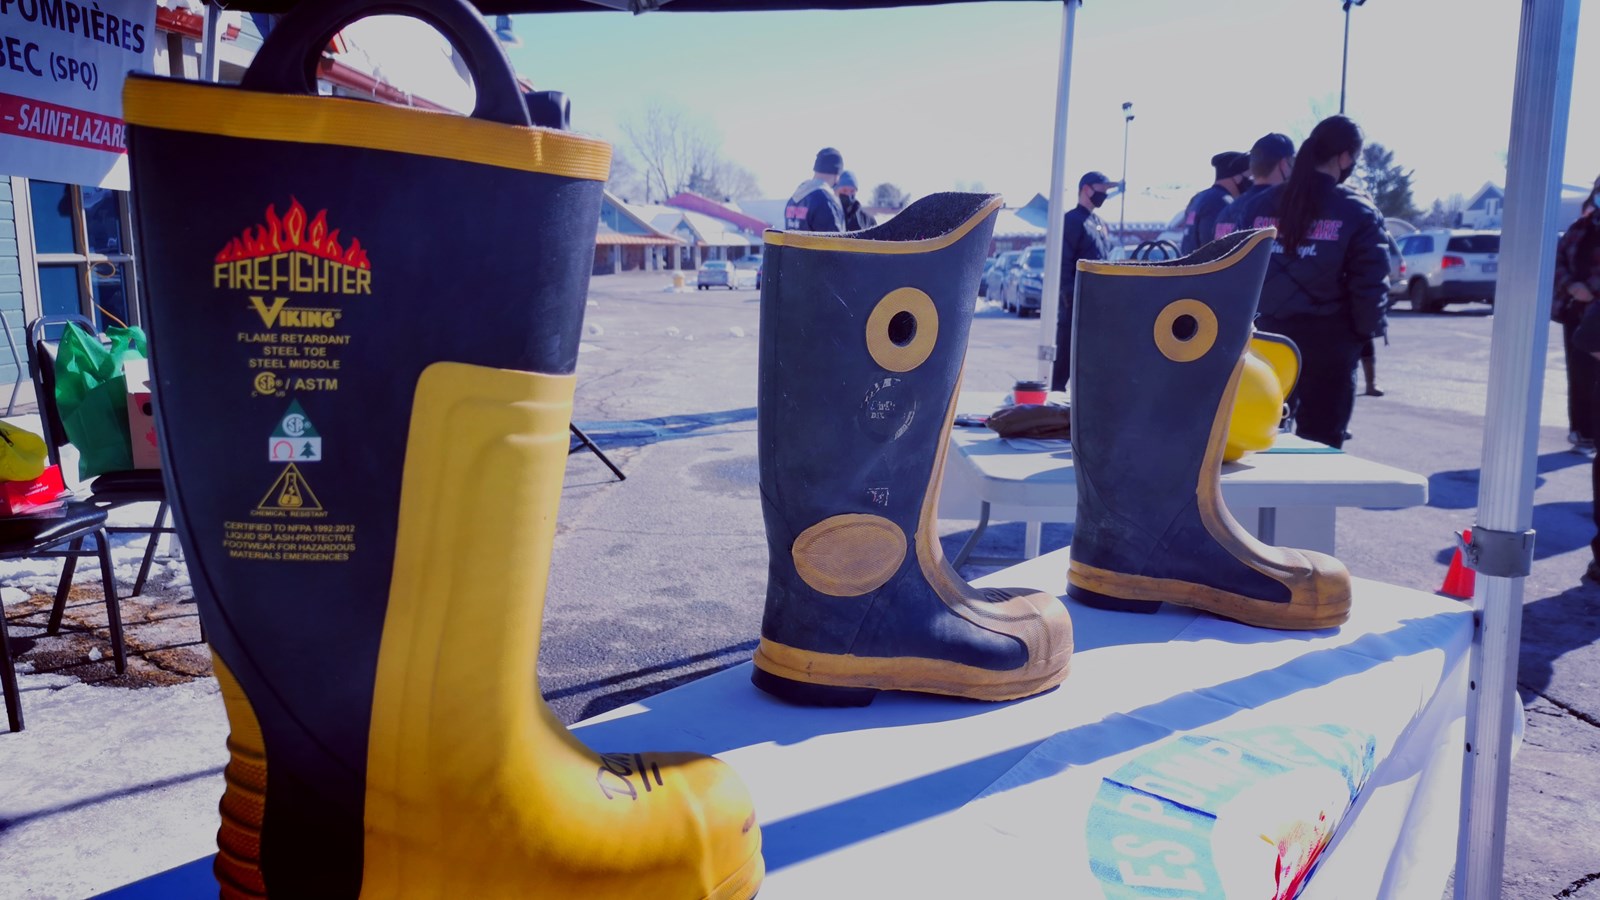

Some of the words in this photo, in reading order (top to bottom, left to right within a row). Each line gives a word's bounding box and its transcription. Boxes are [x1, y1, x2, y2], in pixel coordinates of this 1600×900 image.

[50, 51, 98, 91] (SPQ)
[18, 103, 127, 148] SAINT-LAZARE
[214, 251, 371, 295] FIREFIGHTER
[237, 332, 278, 343] FLAME
[281, 333, 351, 345] RETARDANT
[263, 346, 300, 356] STEEL
[304, 347, 327, 357] TOE
[249, 359, 286, 369] STEEL
[289, 359, 341, 370] MIDSOLE
[294, 378, 338, 391] ASTM
[224, 521, 272, 532] CERTIFIED
[273, 523, 286, 532] TO
[288, 524, 312, 533] NFPA
[225, 531, 256, 541] LIQUID
[223, 540, 276, 551] FOOTWEAR
[277, 542, 297, 552] FOR
[298, 543, 356, 552] HAZARDOUS
[229, 549, 282, 560] MATERIALS
[283, 551, 350, 562] EMERGENCIES
